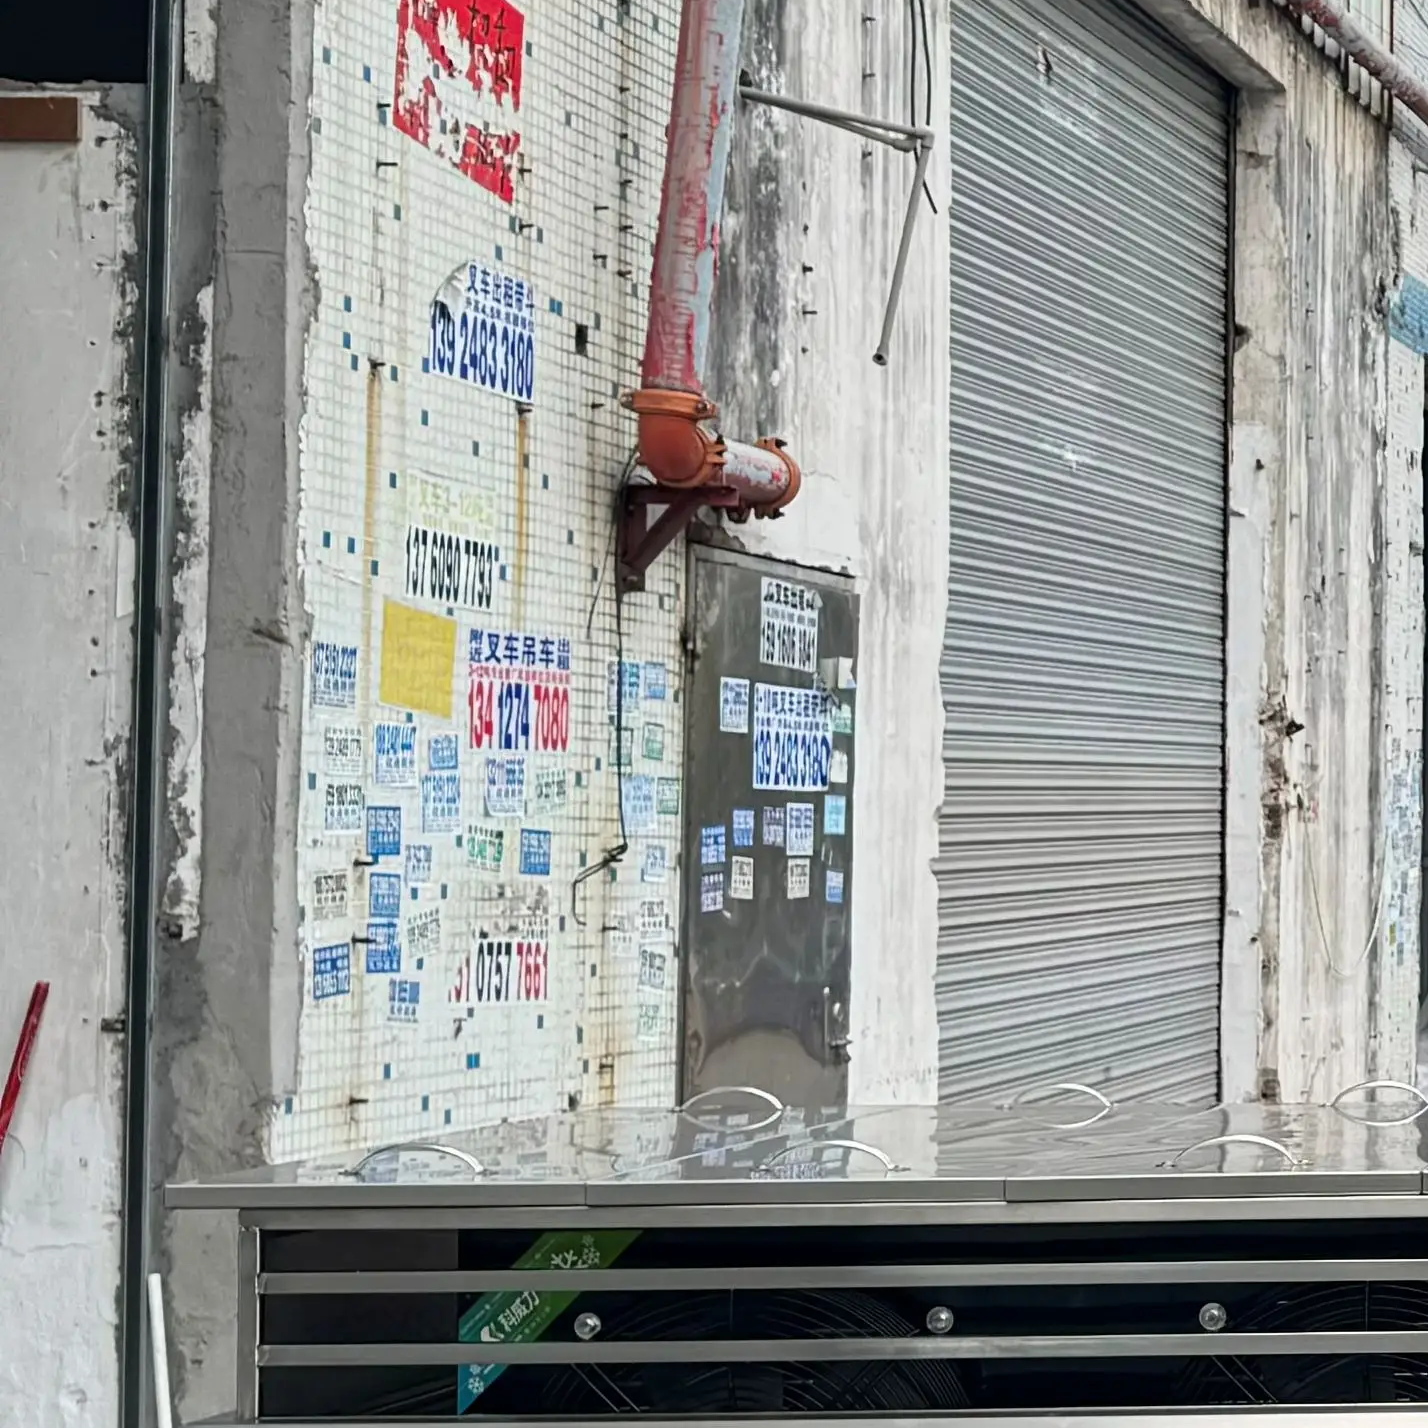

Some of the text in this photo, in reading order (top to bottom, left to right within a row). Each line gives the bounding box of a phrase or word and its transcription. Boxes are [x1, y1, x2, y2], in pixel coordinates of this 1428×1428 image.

[431, 309, 534, 400] 139 2483 3180
[406, 525, 494, 610] 137 6090 7793
[468, 679, 493, 750] 134
[498, 680, 530, 751] 1274
[534, 684, 569, 753] 7080
[755, 729, 831, 788] 139 2483 3180
[476, 942, 512, 1003] 0757
[517, 942, 548, 1002] 7661
